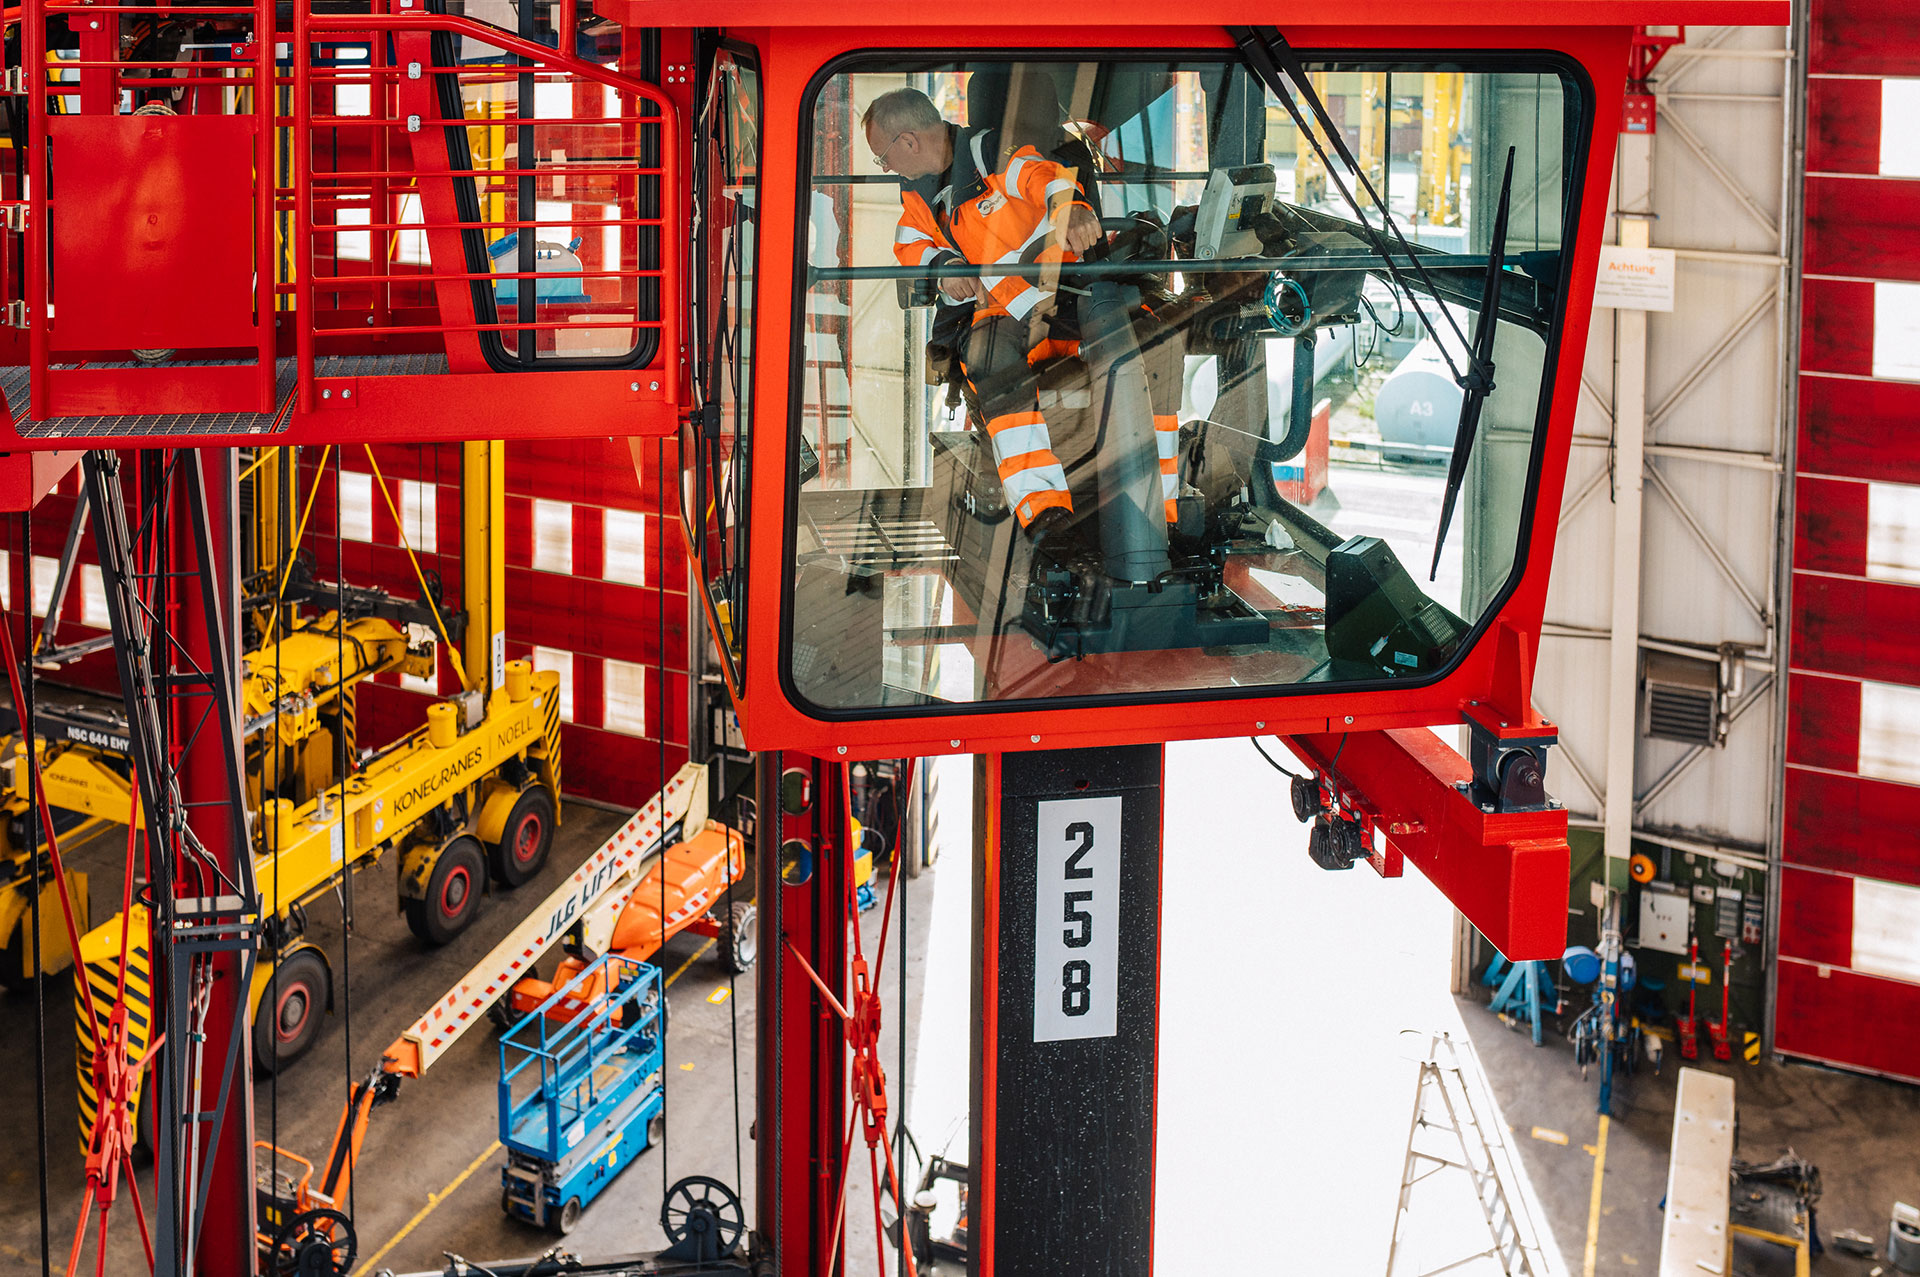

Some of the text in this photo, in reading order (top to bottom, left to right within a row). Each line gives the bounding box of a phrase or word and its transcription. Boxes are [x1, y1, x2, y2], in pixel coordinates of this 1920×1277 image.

[1608, 261, 1656, 275] Achtung
[1410, 400, 1433, 417] A3
[67, 726, 87, 741] NSC
[89, 731, 108, 747] 644
[393, 716, 533, 816] KONECRANES NOELL
[546, 856, 617, 942] JLG LIFT
[1062, 821, 1094, 1017] 258
